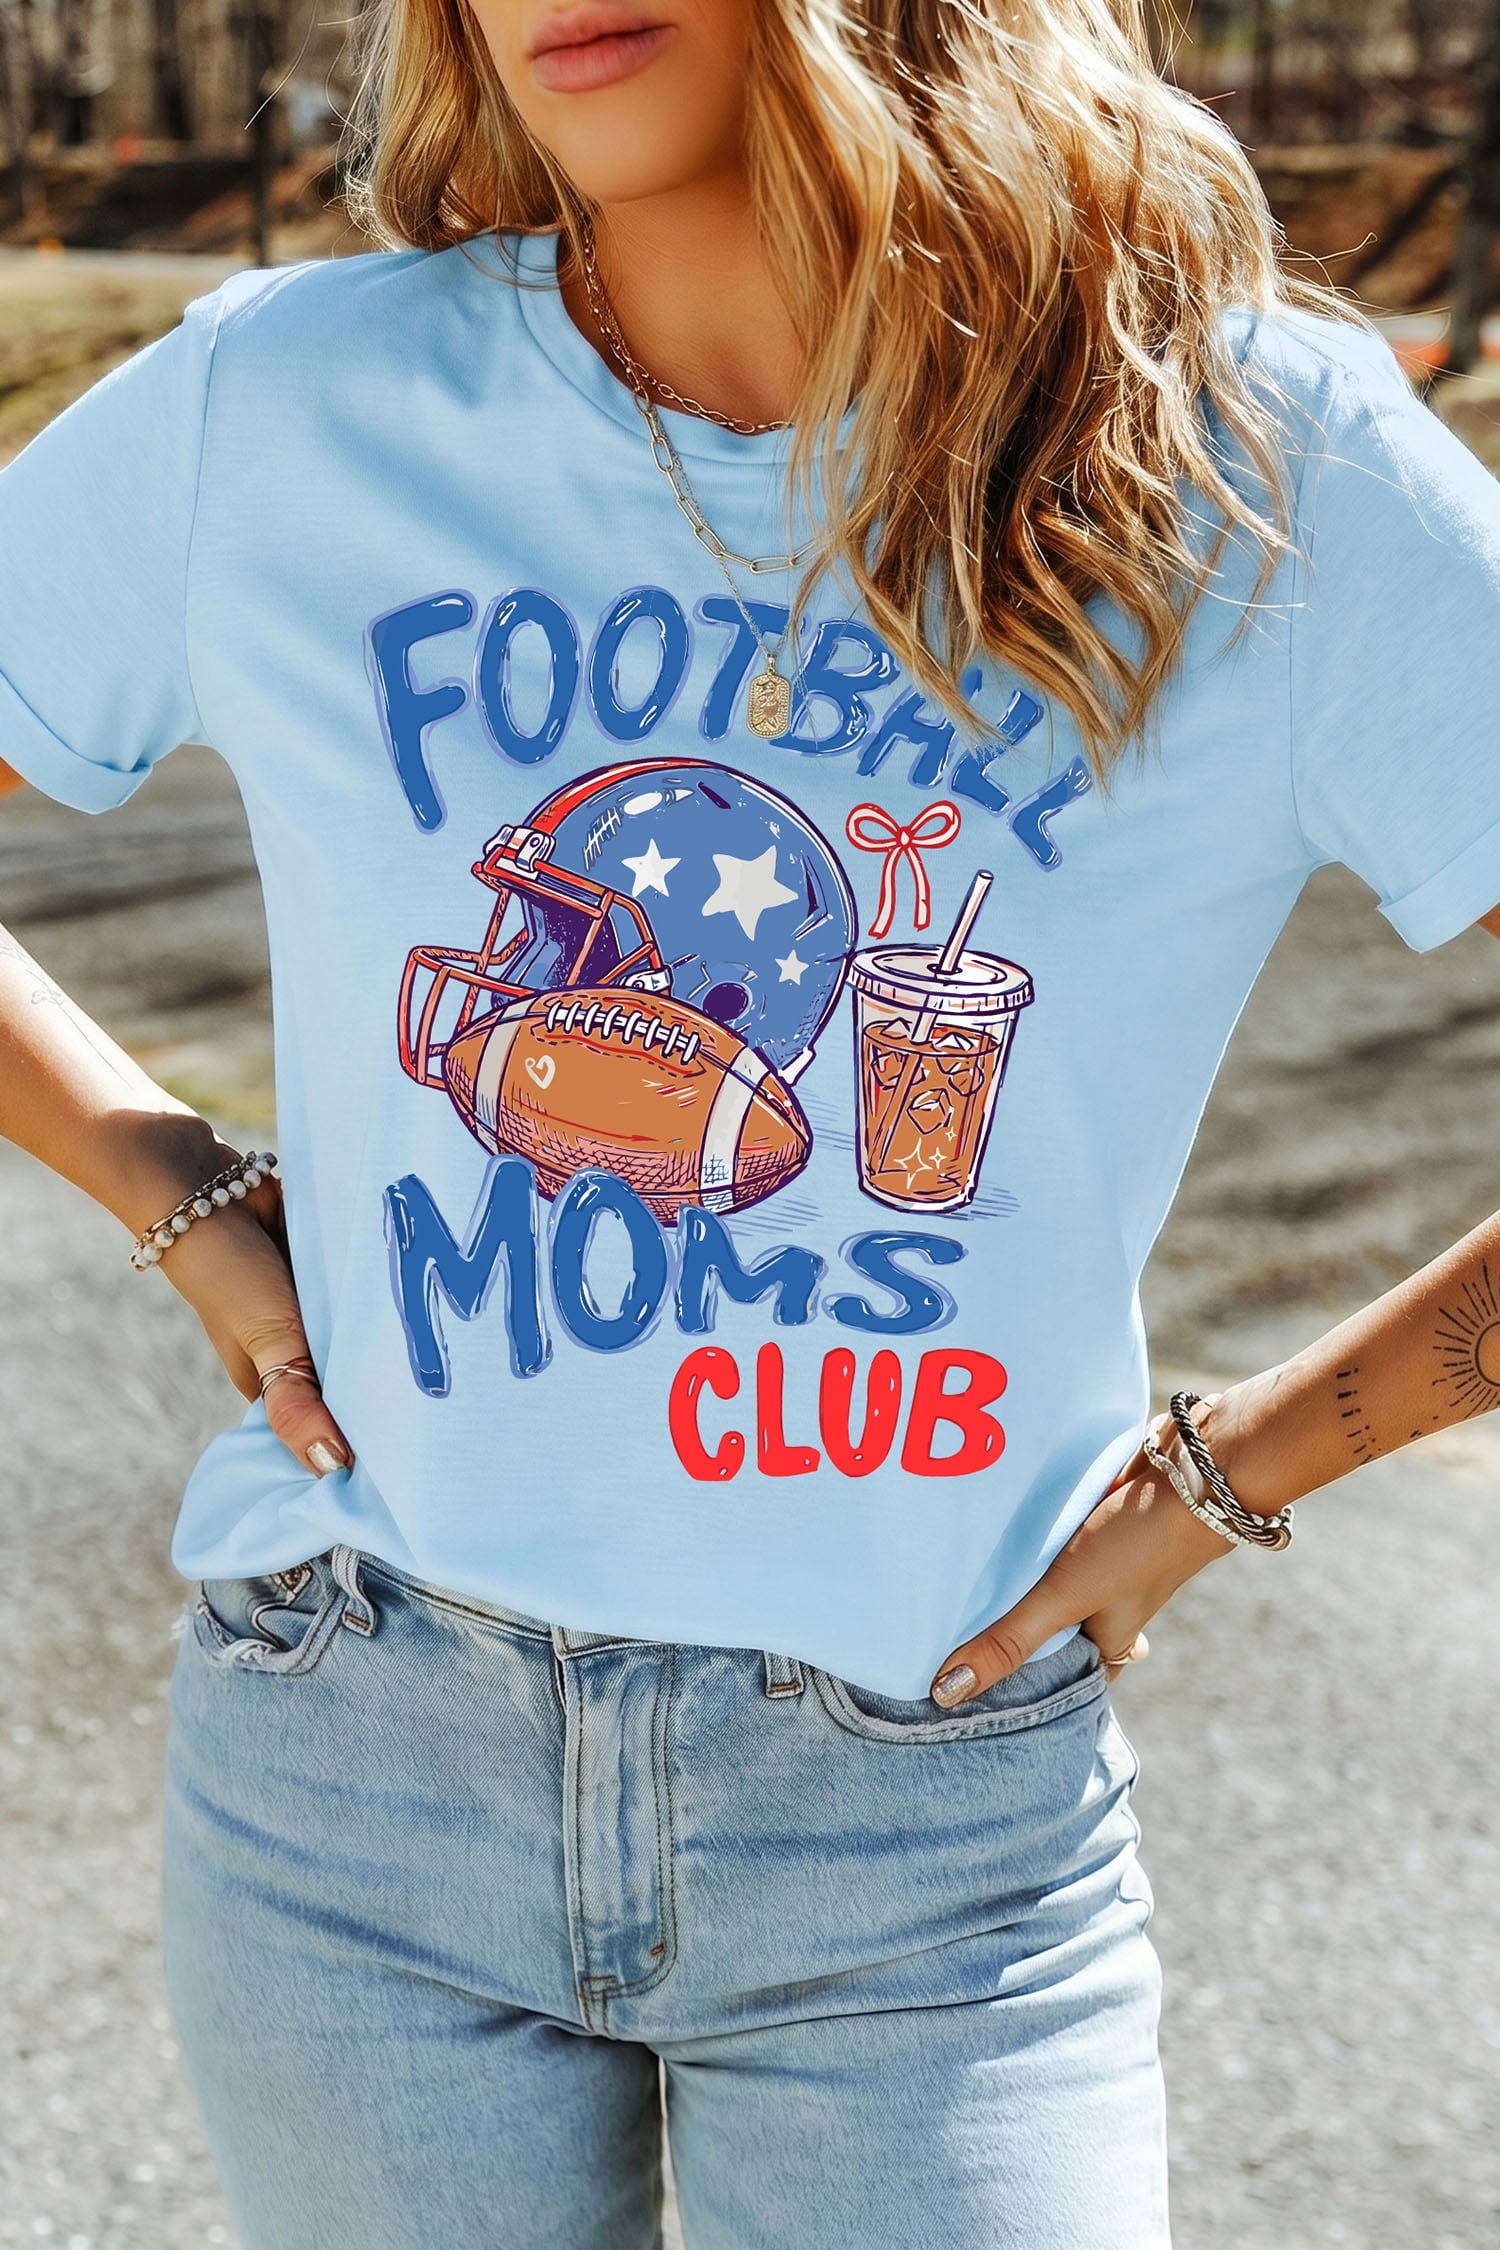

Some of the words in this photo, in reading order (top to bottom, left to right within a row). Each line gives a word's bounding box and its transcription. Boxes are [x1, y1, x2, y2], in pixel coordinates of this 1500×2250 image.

[366, 585, 1094, 872] FOOTBALL
[383, 1155, 968, 1399] MOMS
[668, 1341, 1008, 1482] CLUB
